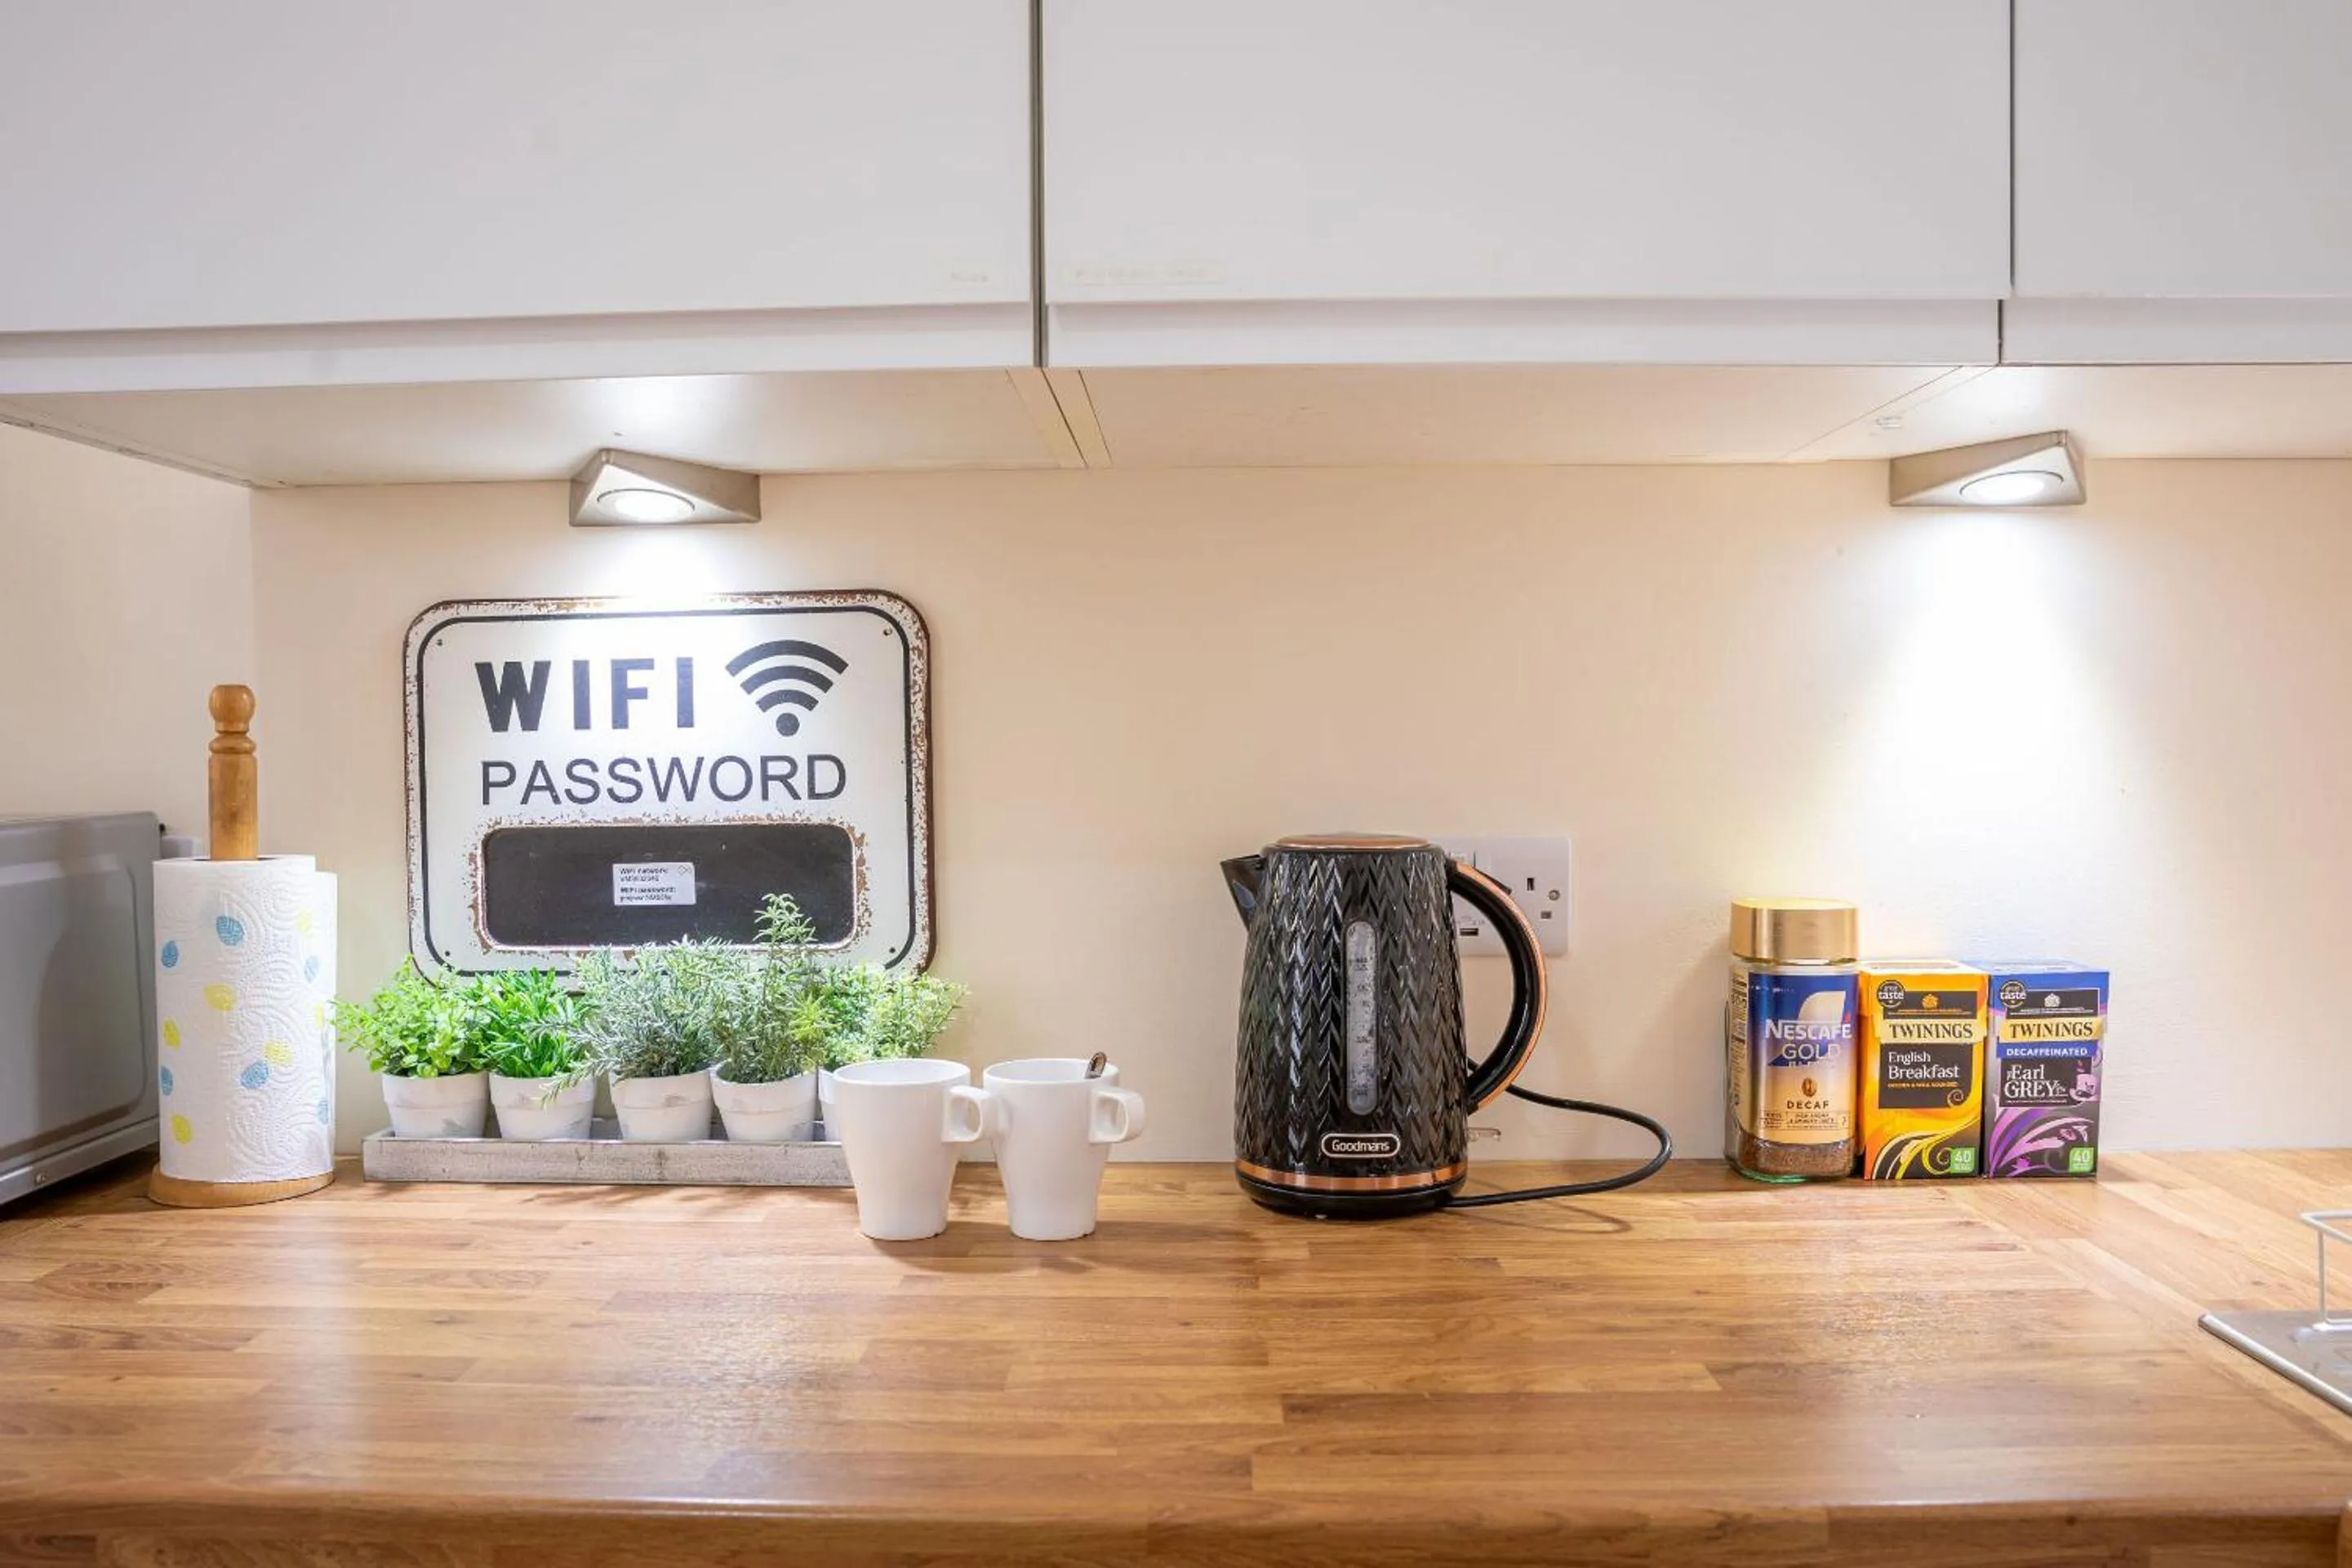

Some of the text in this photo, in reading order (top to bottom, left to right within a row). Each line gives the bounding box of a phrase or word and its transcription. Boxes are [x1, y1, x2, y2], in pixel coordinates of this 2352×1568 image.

[474, 656, 695, 733] WIFI
[481, 753, 847, 806] PASSWORD
[1889, 1023, 1973, 1039] TWININGS
[2009, 1021, 2093, 1039] TWININGS
[1782, 1043, 1841, 1060] GOLD
[1887, 1051, 1932, 1065] English
[2006, 1047, 2088, 1057] DECAFFEINATED
[1887, 1064, 1960, 1079] Breakfast
[2011, 1064, 2045, 1081] Earl
[2003, 1079, 2059, 1099] GREY
[1786, 1099, 1830, 1110] DECAF
[1332, 1139, 1390, 1153] Goodmans
[1954, 1149, 1972, 1162] 40
[2073, 1149, 2090, 1162] 40
